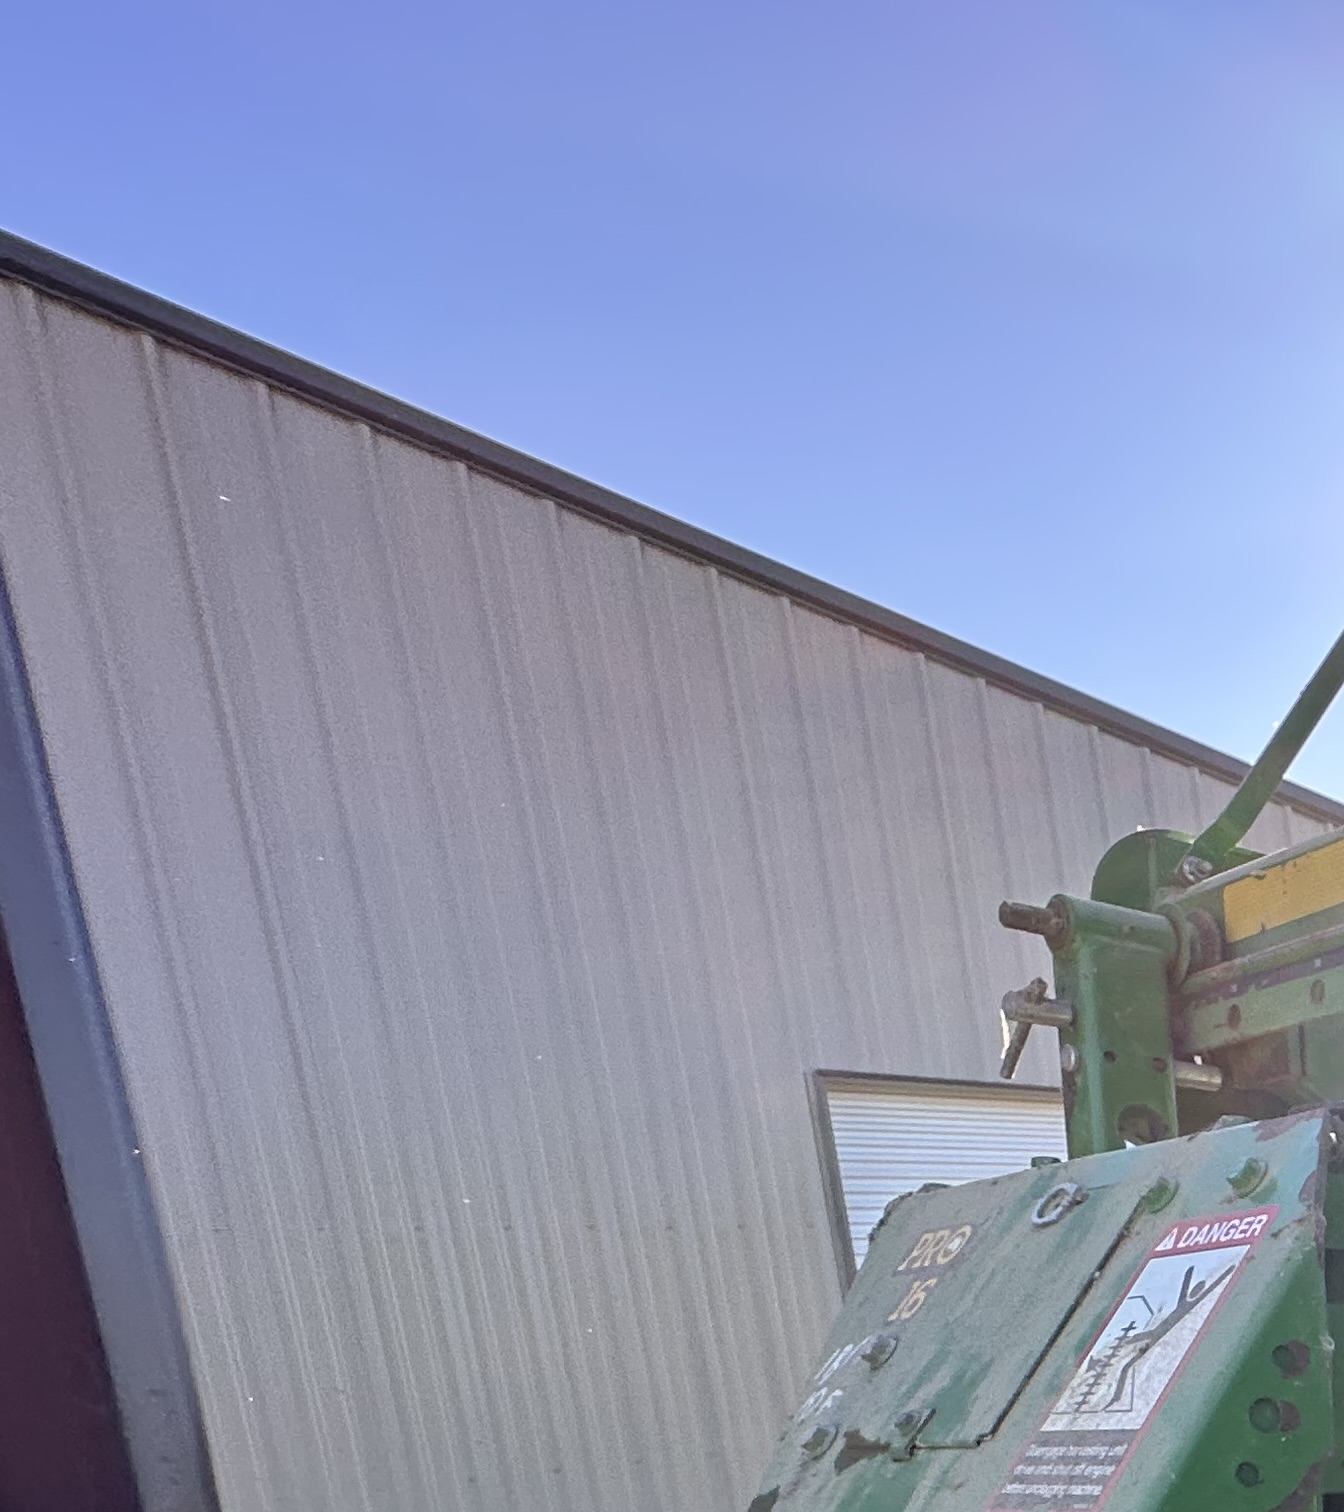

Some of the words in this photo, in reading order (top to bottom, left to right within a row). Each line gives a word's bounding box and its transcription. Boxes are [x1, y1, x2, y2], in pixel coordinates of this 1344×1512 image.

[897, 1225, 972, 1271] PRO
[1176, 1214, 1269, 1249] DANGER
[887, 1279, 937, 1321] 16
